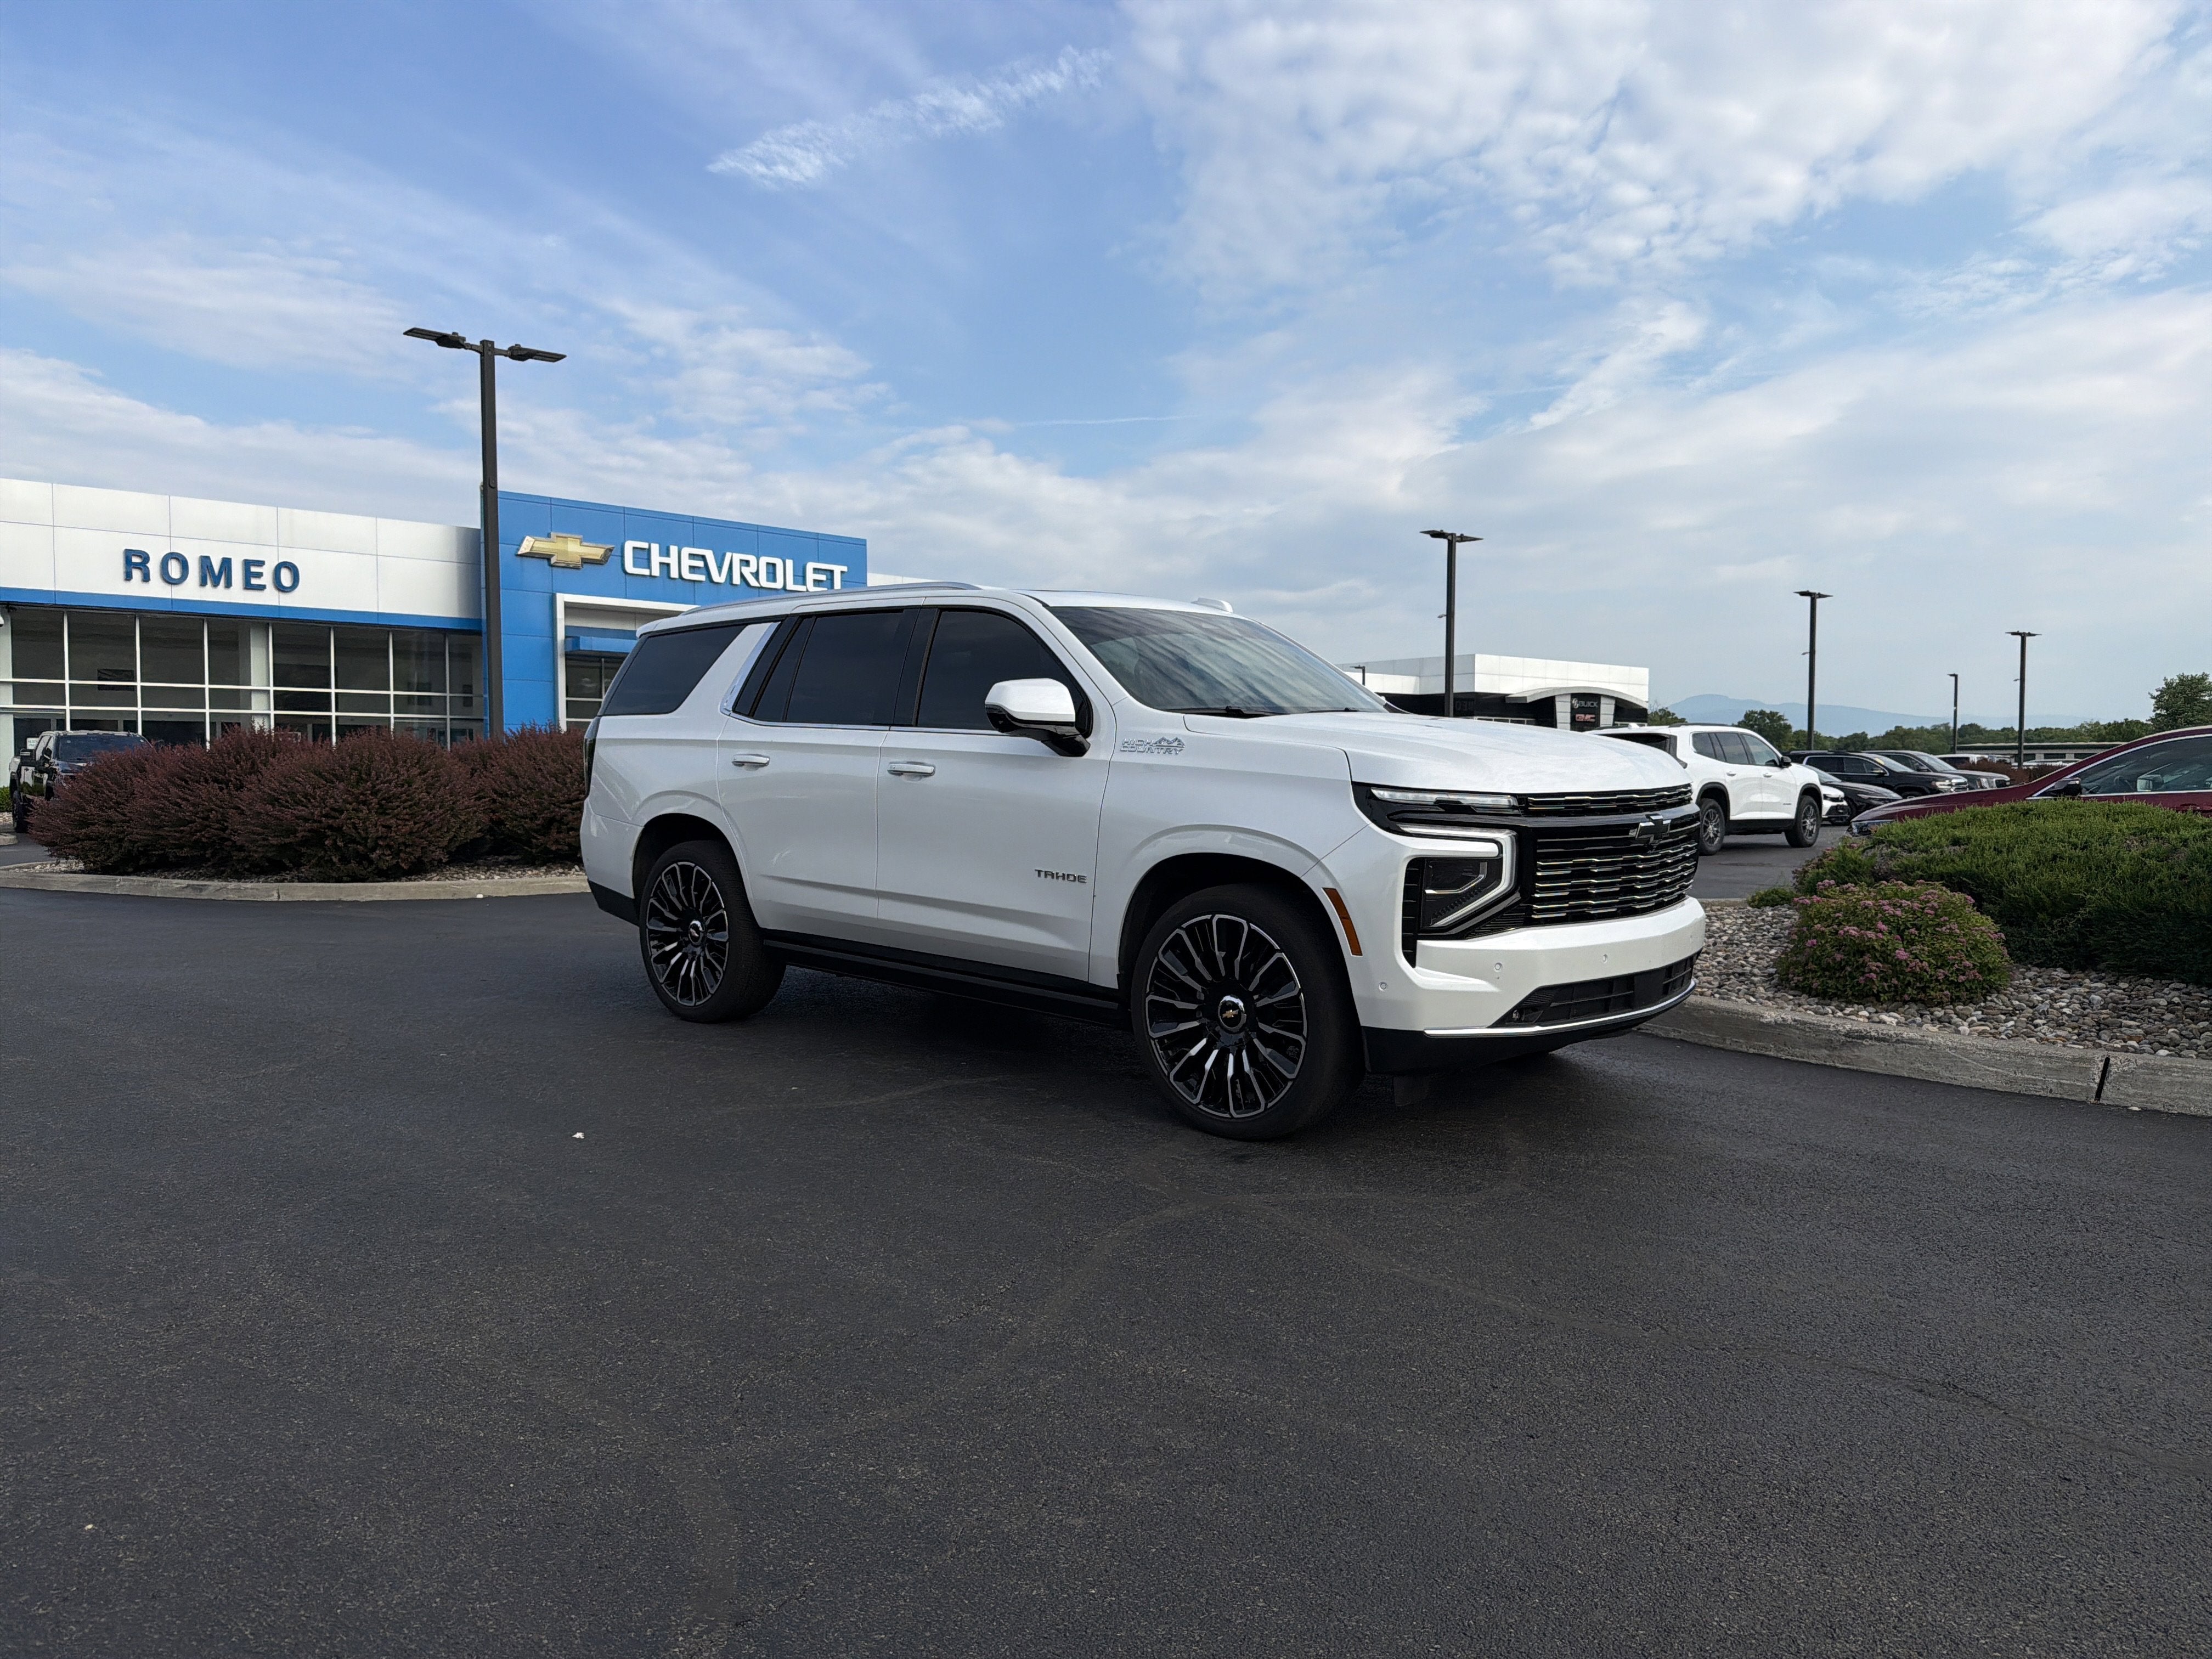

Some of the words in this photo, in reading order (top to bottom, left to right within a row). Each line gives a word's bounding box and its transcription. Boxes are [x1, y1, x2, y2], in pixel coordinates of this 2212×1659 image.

[123, 548, 300, 592] ROMEO
[624, 540, 848, 592] CHEVROLET
[1575, 714, 1595, 722] GMC
[1121, 738, 1155, 746] HIGH
[1120, 746, 1184, 755] COUNTRY
[1034, 868, 1087, 883] TAHOE
